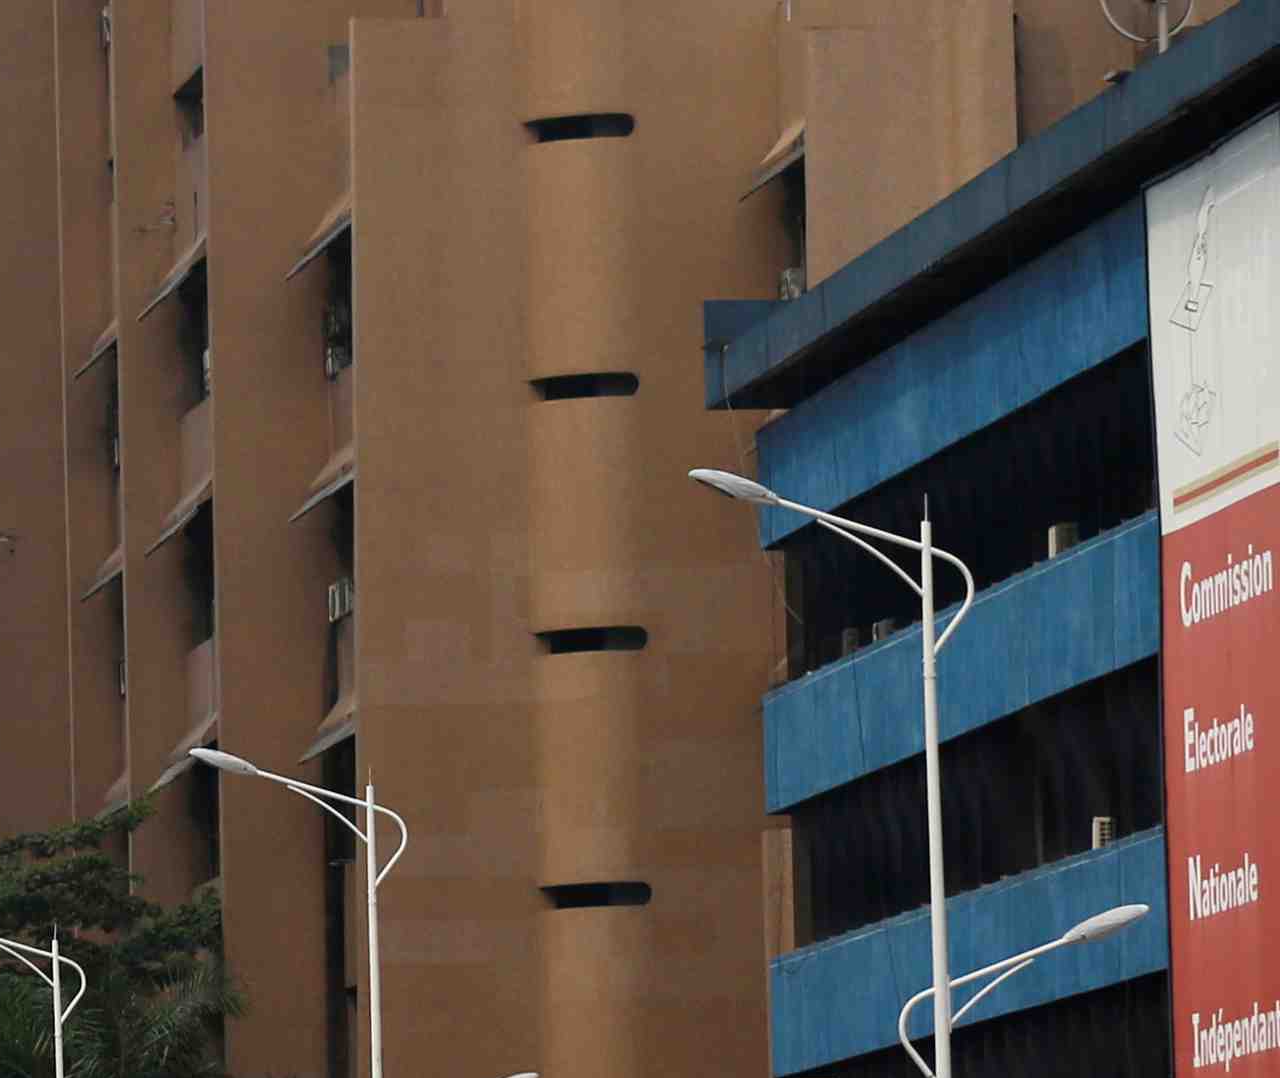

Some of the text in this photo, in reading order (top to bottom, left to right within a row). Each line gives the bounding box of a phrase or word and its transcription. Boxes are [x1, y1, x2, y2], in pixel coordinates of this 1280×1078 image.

[1180, 543, 1273, 628] Commission
[1183, 703, 1254, 773] Electorale
[1188, 852, 1259, 921] Nationale
